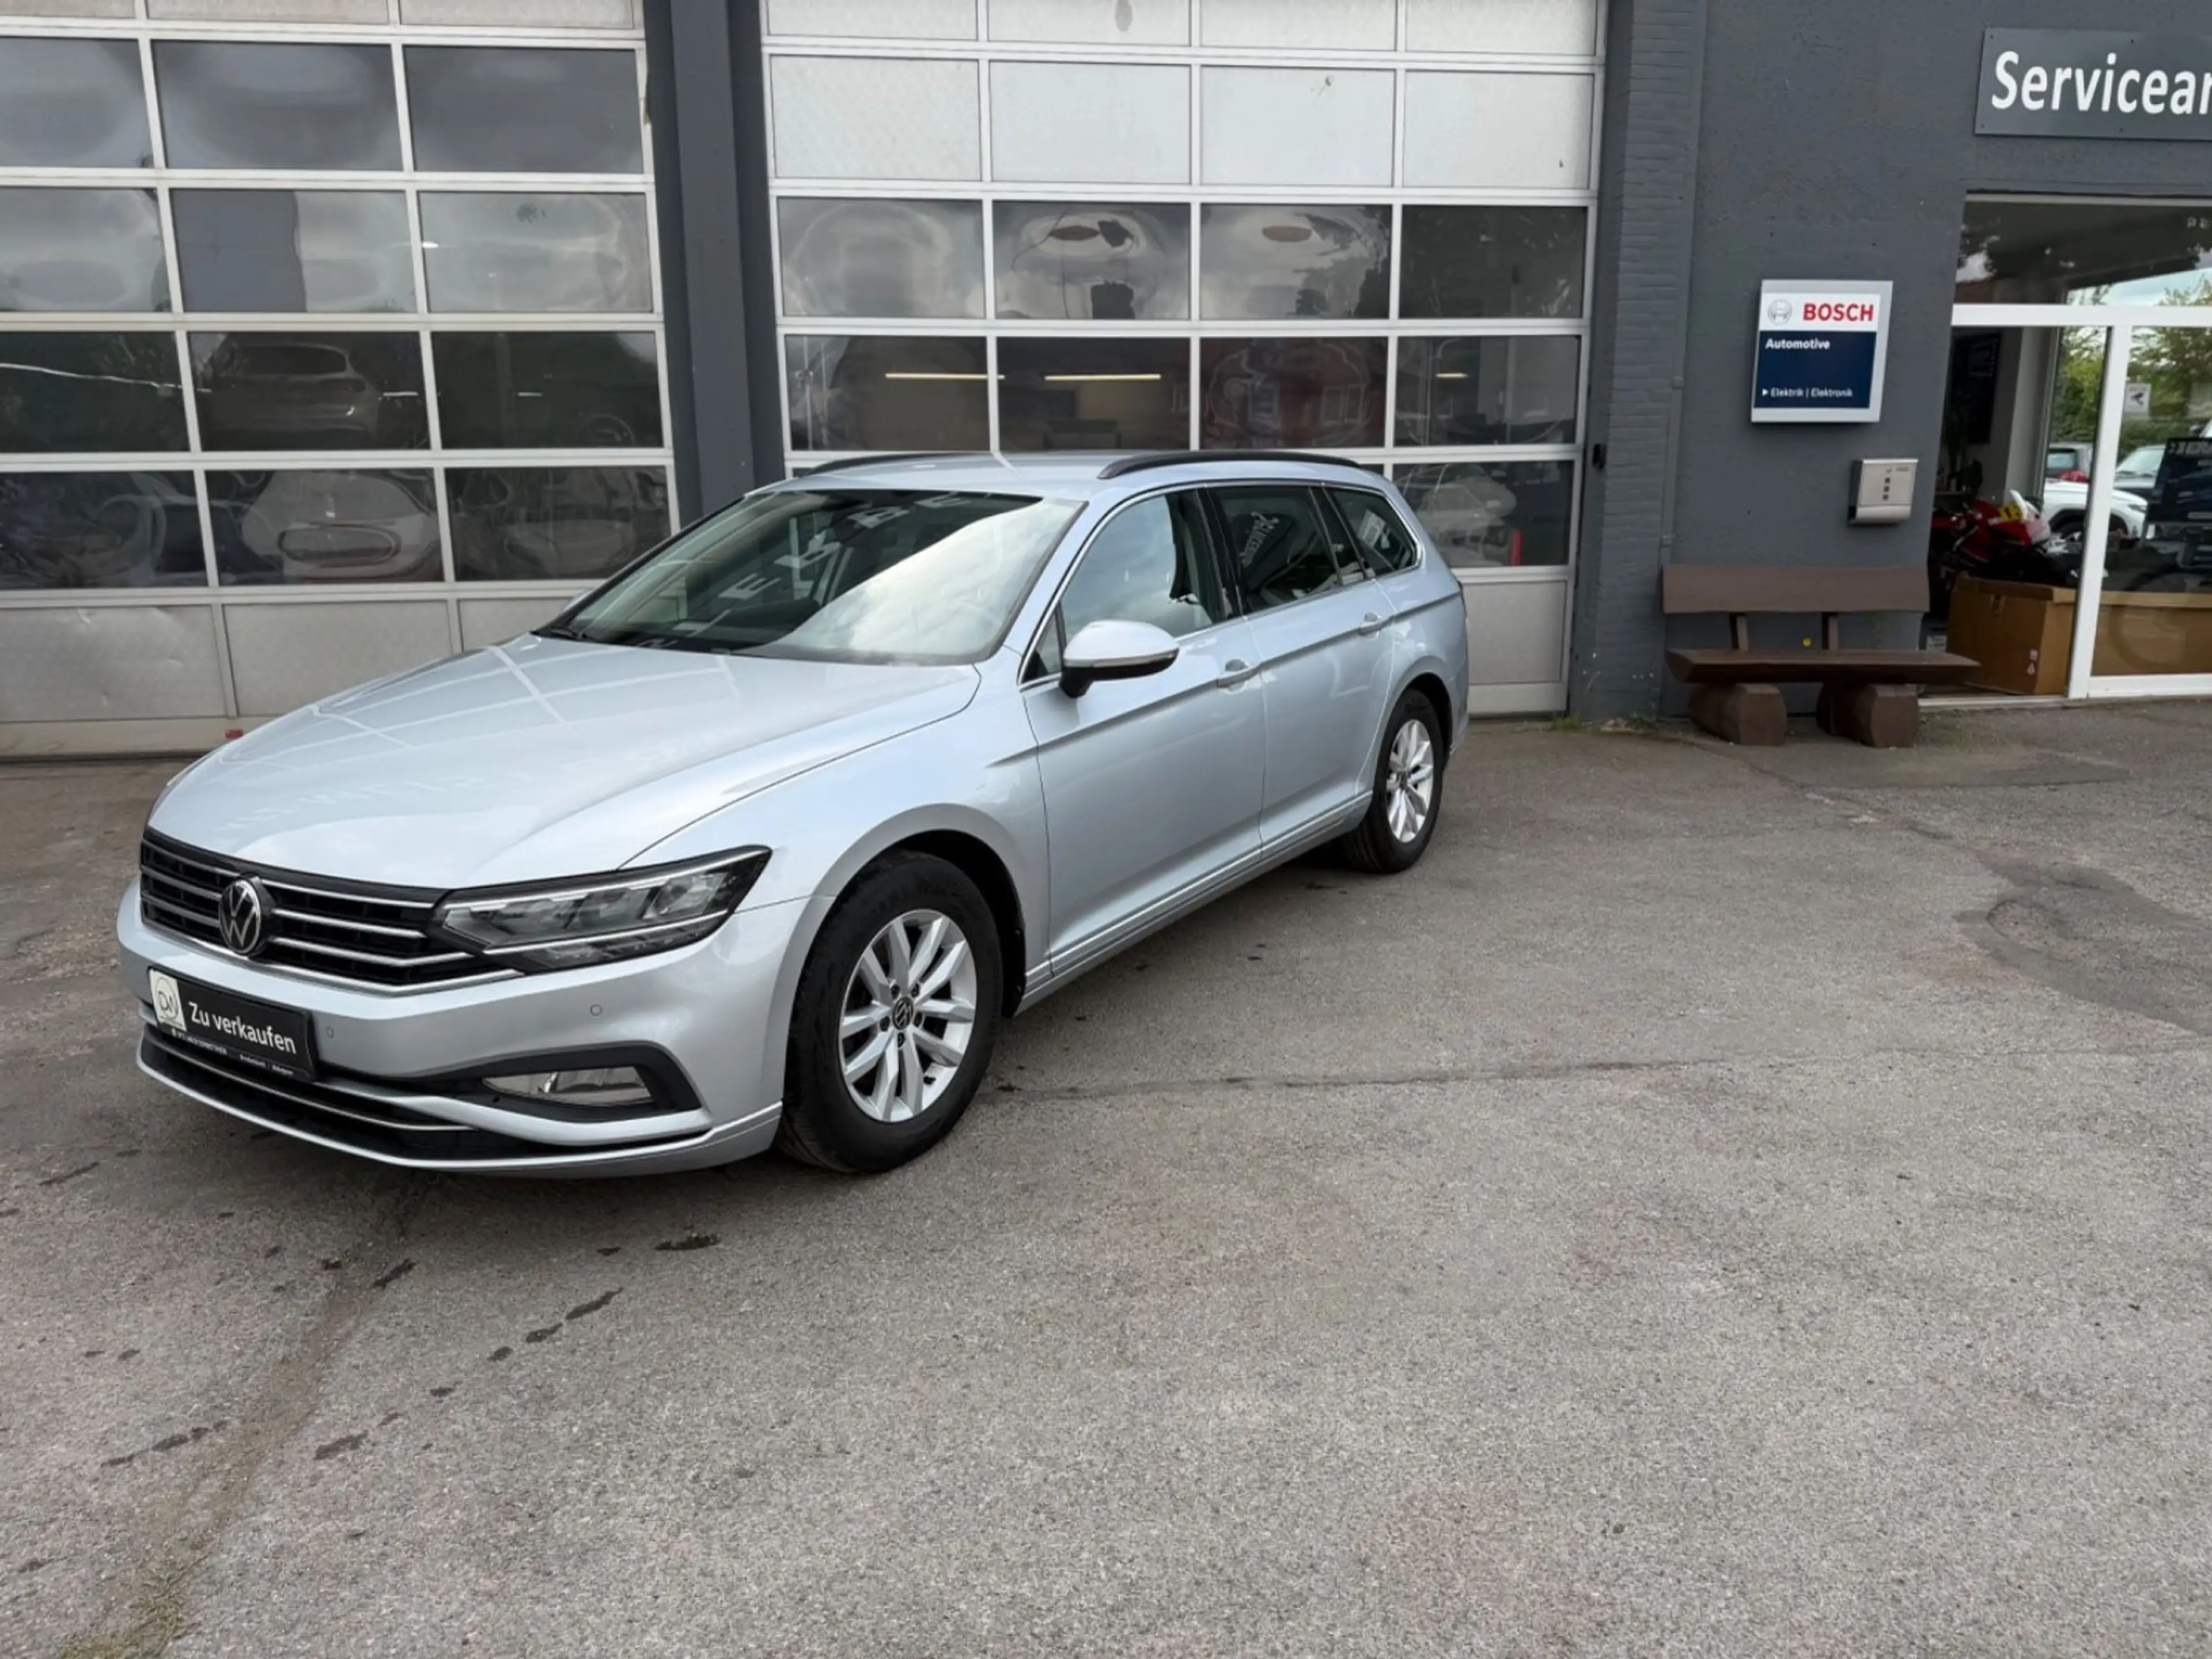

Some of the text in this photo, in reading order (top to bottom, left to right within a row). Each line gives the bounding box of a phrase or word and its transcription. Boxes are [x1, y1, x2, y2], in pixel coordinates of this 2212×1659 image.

[1802, 303, 1874, 321] BOSCH
[1765, 338, 1831, 350] Automotive
[1770, 388, 1853, 397] Elektrik Elektronik
[188, 1001, 211, 1027] Zu
[212, 1014, 297, 1055] verkaufen
